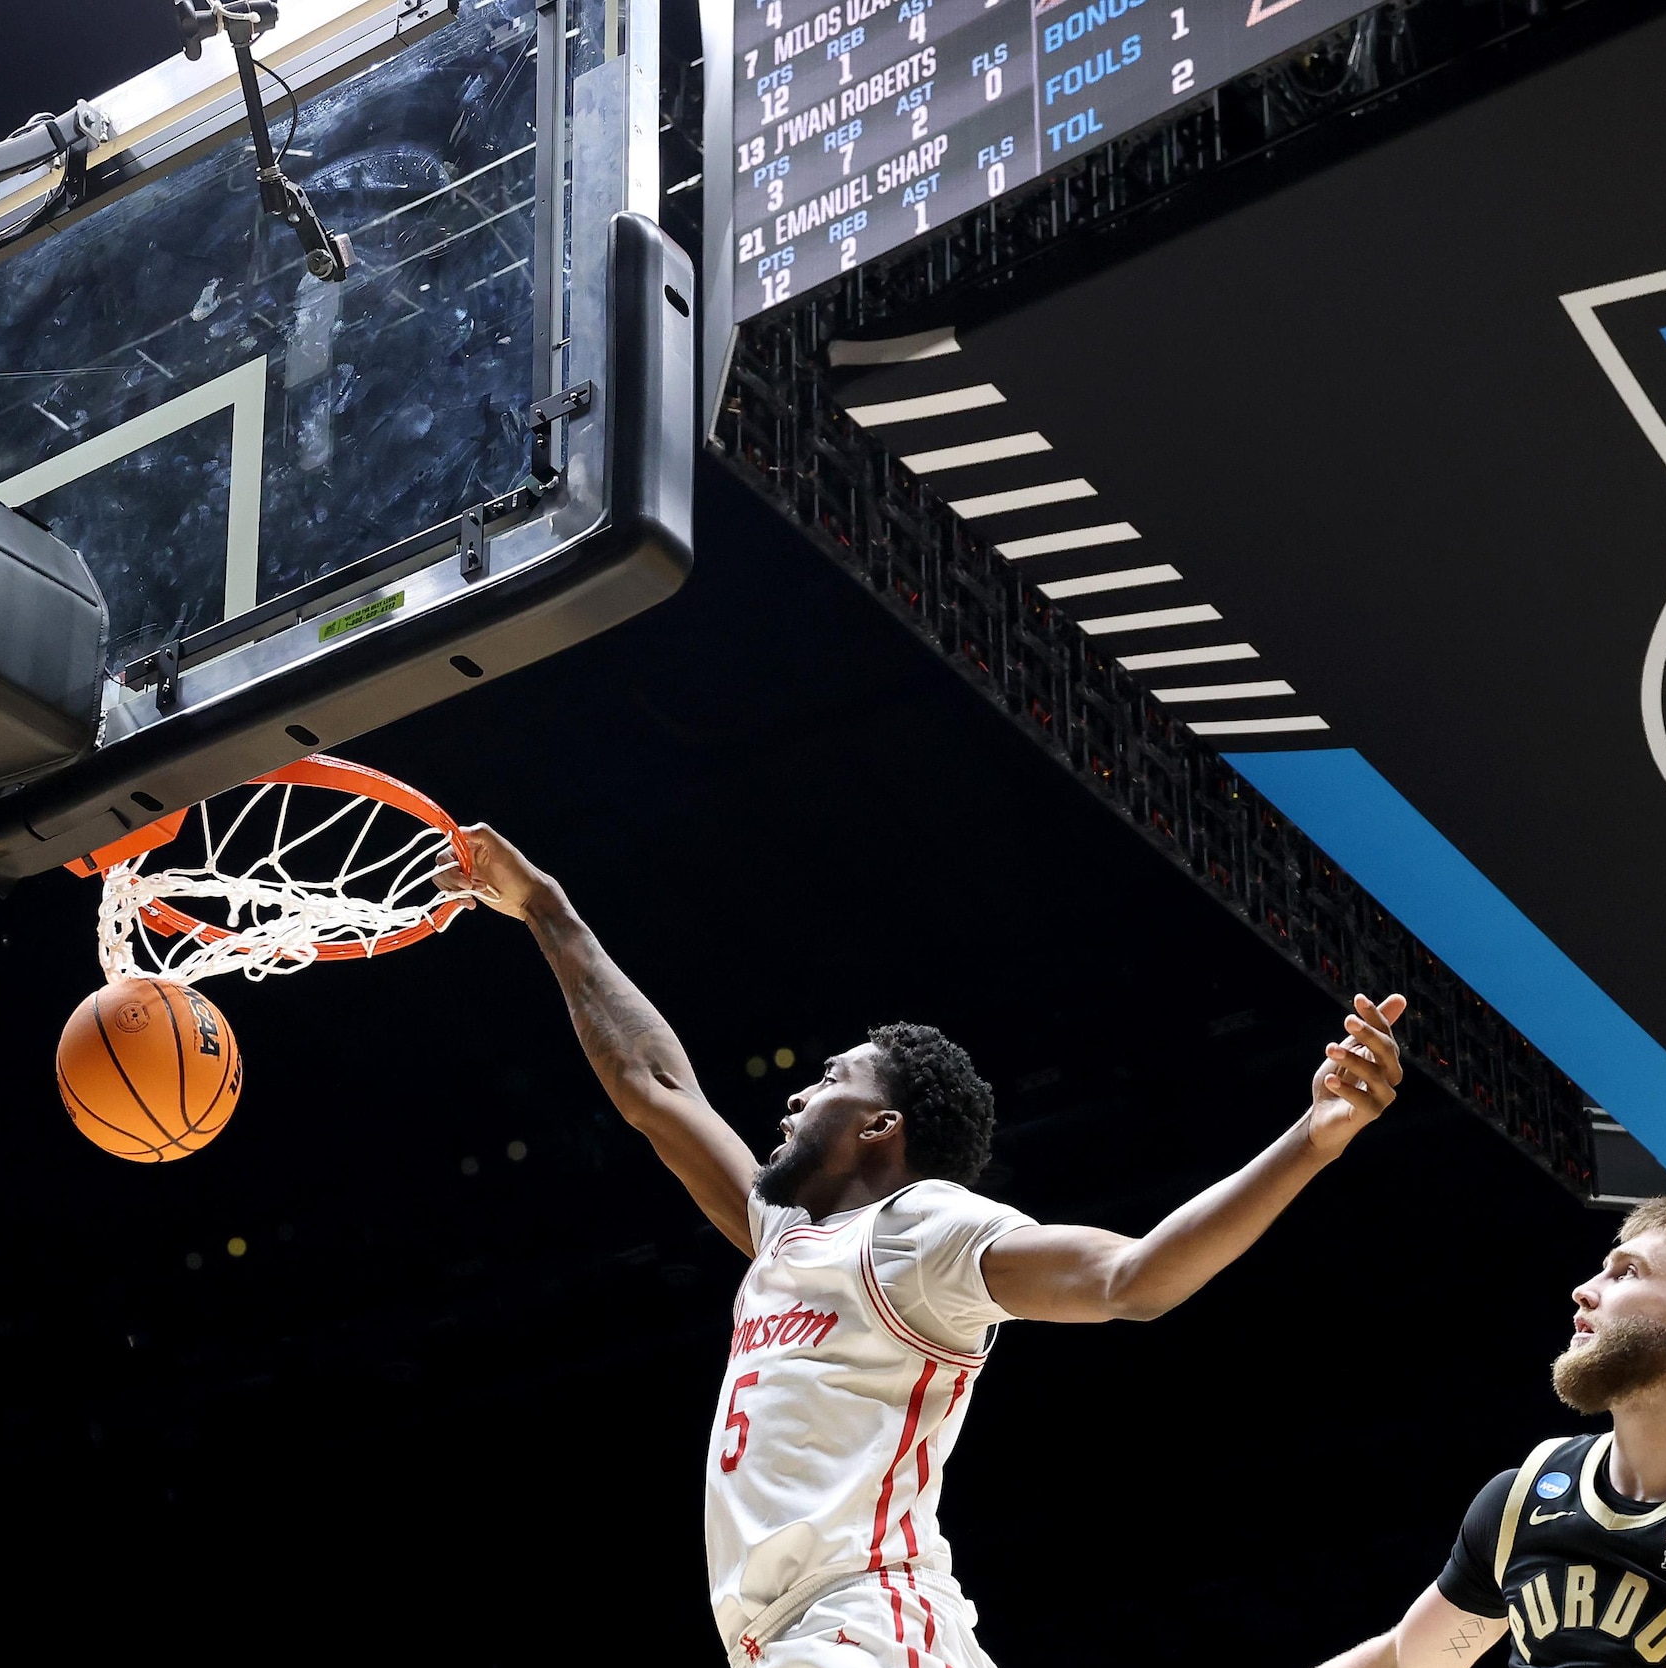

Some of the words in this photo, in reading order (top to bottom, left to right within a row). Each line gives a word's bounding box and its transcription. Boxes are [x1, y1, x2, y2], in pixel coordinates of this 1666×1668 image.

[908, 12, 927, 44] 4
[1044, 0, 1146, 53] BONU
[1170, 7, 1190, 41] 1
[744, 49, 758, 80] 7
[774, 5, 842, 65] MILOS
[826, 26, 866, 61] REB
[971, 43, 1008, 77] FLS
[756, 63, 794, 97] PTS
[838, 52, 853, 86] 1
[984, 66, 1003, 102] 0
[1045, 34, 1142, 105] FOULS
[1171, 58, 1195, 95] 2
[737, 136, 765, 173] 13
[773, 98, 836, 155] J'WAN
[840, 46, 937, 121] ROBERTS
[760, 85, 790, 125] 12
[896, 81, 935, 116] AST
[823, 119, 863, 153] REB
[910, 104, 929, 141] 2
[1046, 107, 1104, 152] TOL
[838, 141, 855, 176] 7
[977, 136, 1015, 170] FLS
[753, 155, 791, 188] PTS
[987, 162, 1006, 198] 0
[738, 226, 765, 264] 21
[775, 174, 873, 246] EMANUEL
[876, 133, 949, 195] SHARP
[766, 179, 785, 212] 3
[901, 173, 941, 208] AST
[828, 209, 868, 244] REB
[913, 200, 931, 236] 1
[757, 245, 795, 279] PTS
[840, 237, 857, 272] 2
[760, 268, 792, 310] 12
[731, 1301, 839, 1361] ouston
[719, 1371, 760, 1475] 5
